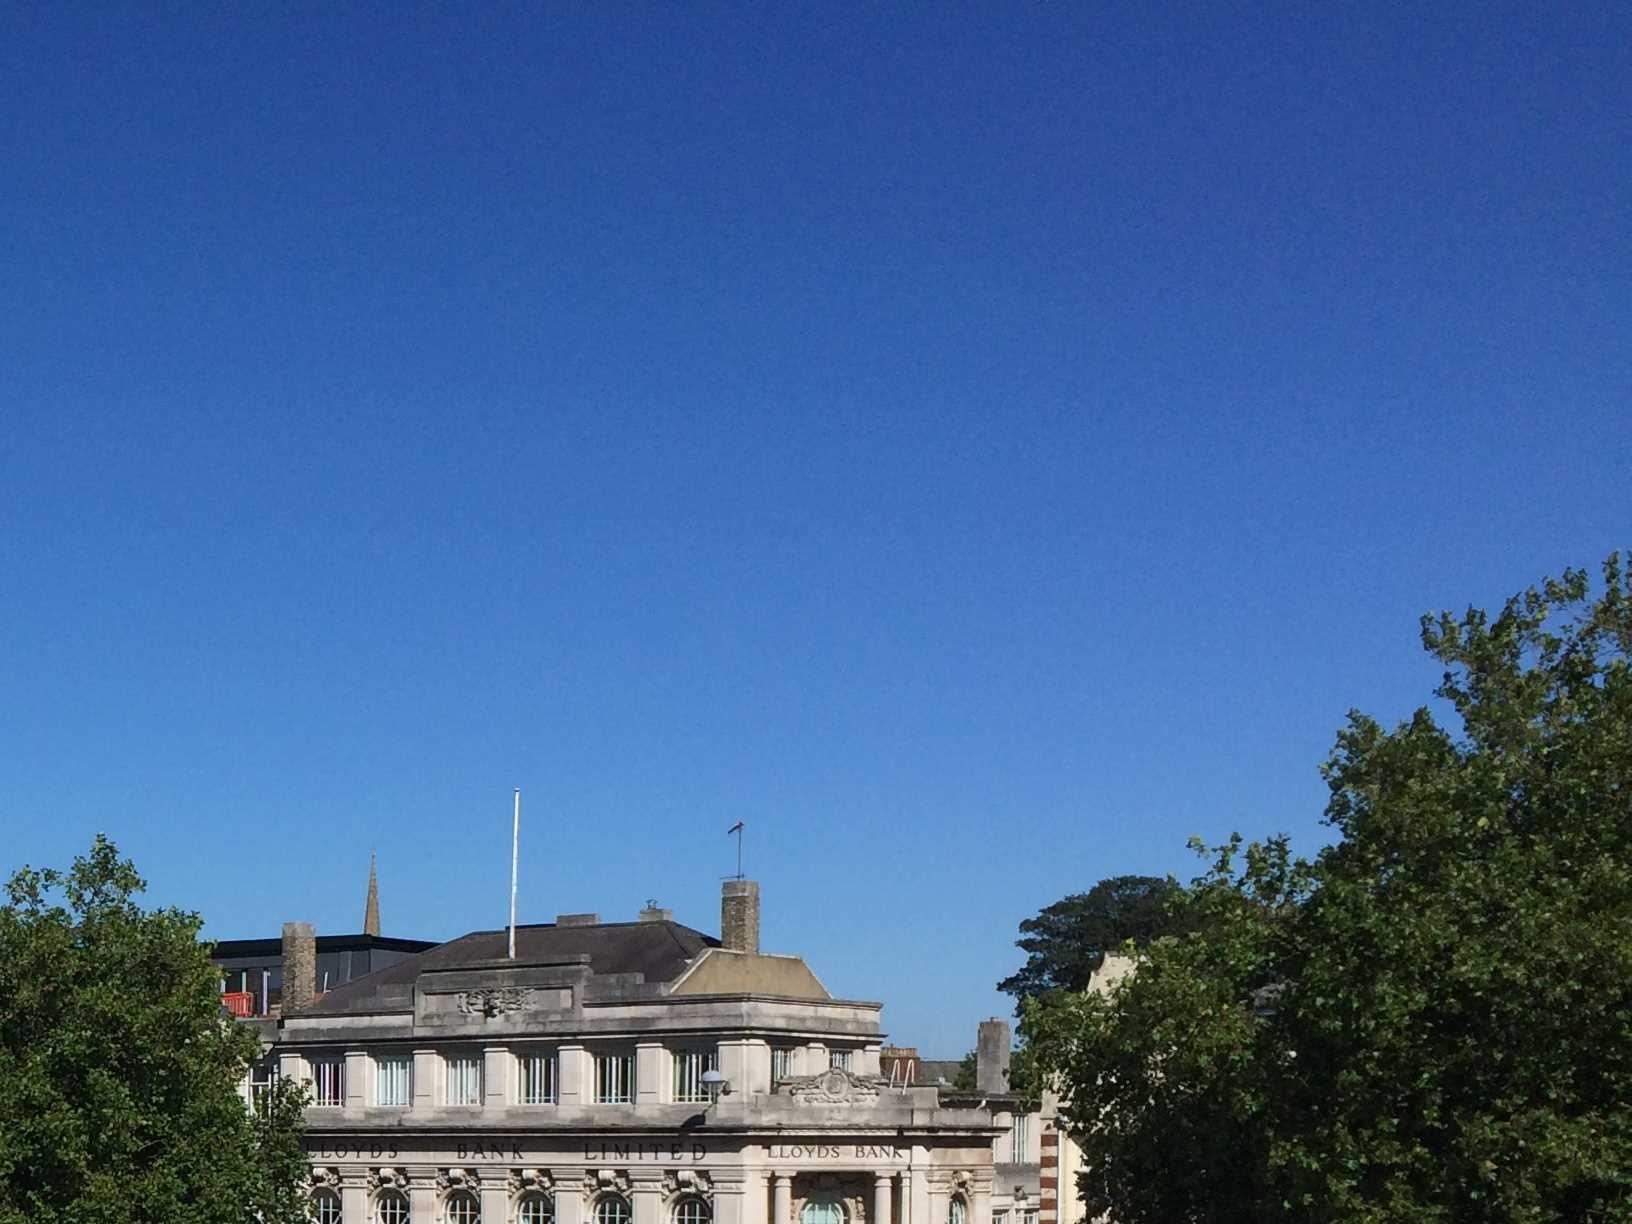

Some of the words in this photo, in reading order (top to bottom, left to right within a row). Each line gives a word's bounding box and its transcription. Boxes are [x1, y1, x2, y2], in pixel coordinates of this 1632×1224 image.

[304, 1142, 399, 1160] LLOYDS
[456, 1142, 525, 1160] BANK
[583, 1142, 708, 1160] LIMITED
[767, 1145, 841, 1159] LLOYDS
[854, 1145, 905, 1159] BANK
